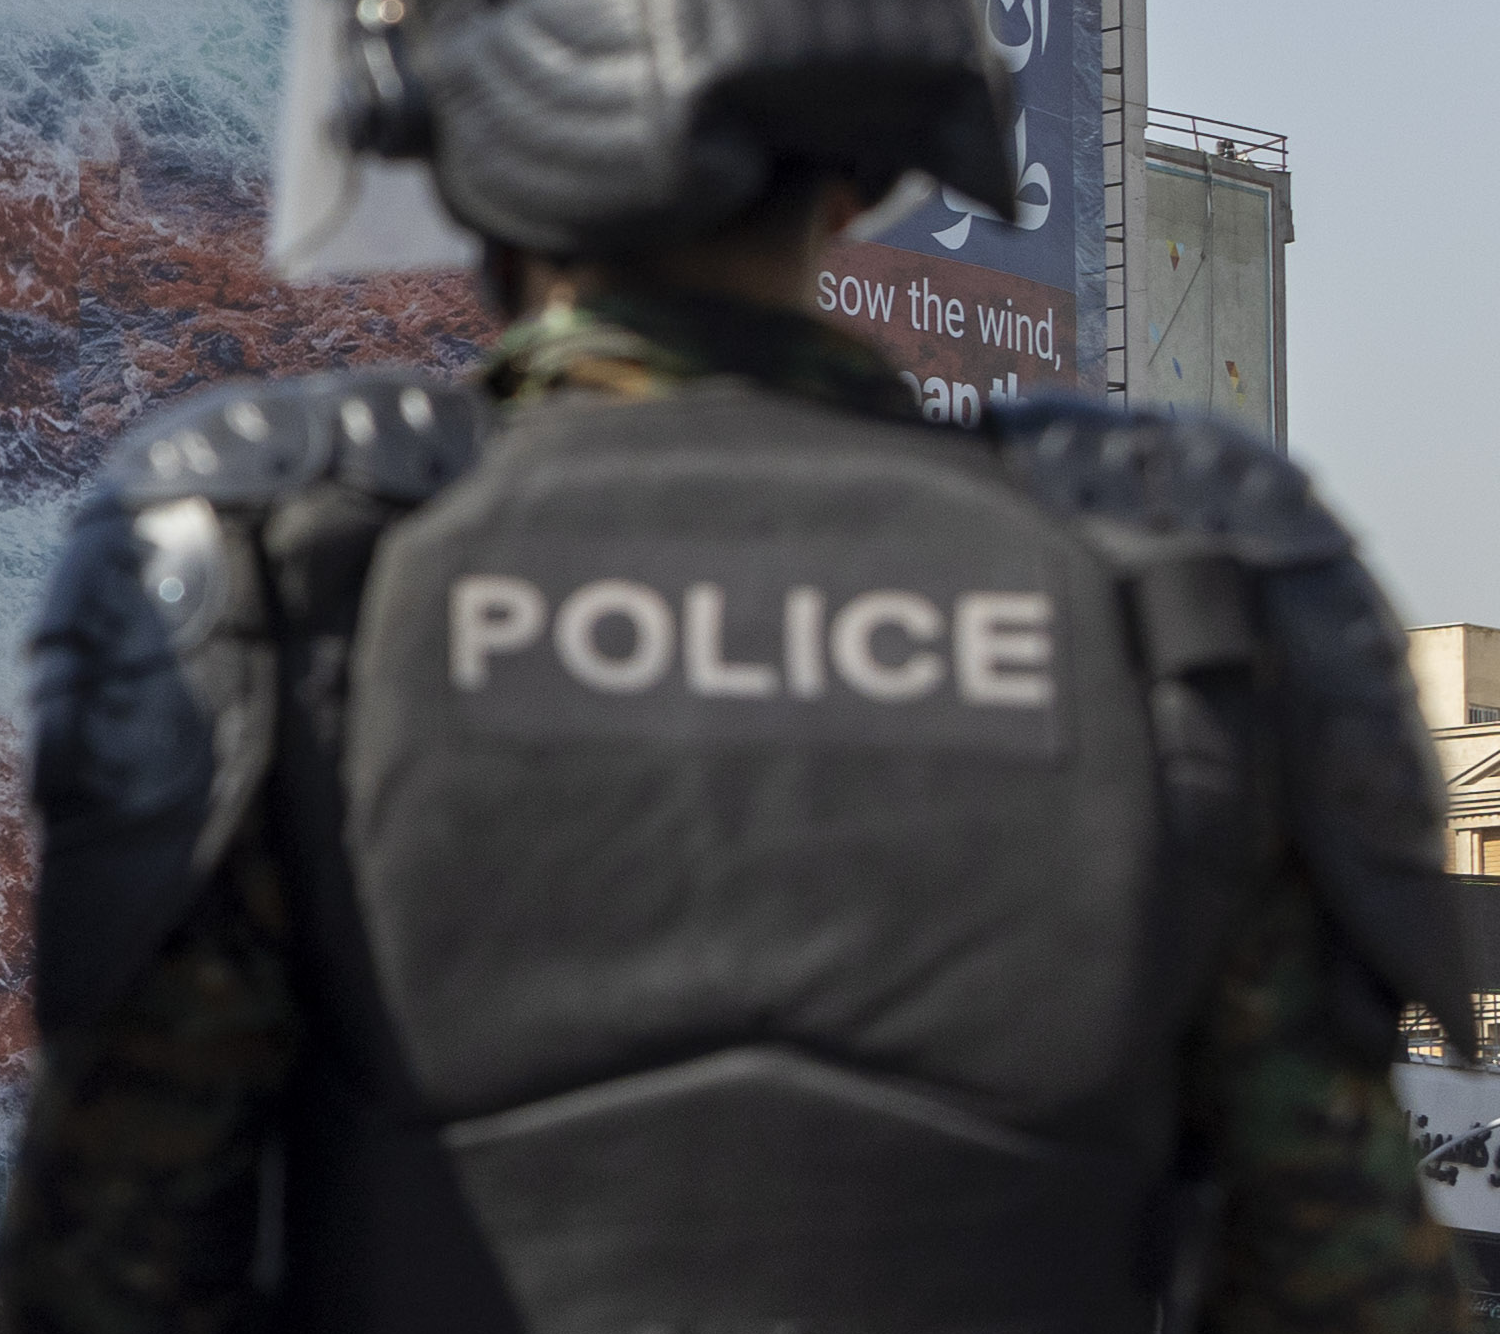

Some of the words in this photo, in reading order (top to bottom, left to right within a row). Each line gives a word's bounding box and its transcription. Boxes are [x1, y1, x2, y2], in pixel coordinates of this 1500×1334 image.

[817, 270, 895, 323] sow
[907, 277, 965, 338] the
[977, 298, 1061, 371] wind,
[446, 573, 1056, 707] POLICE
